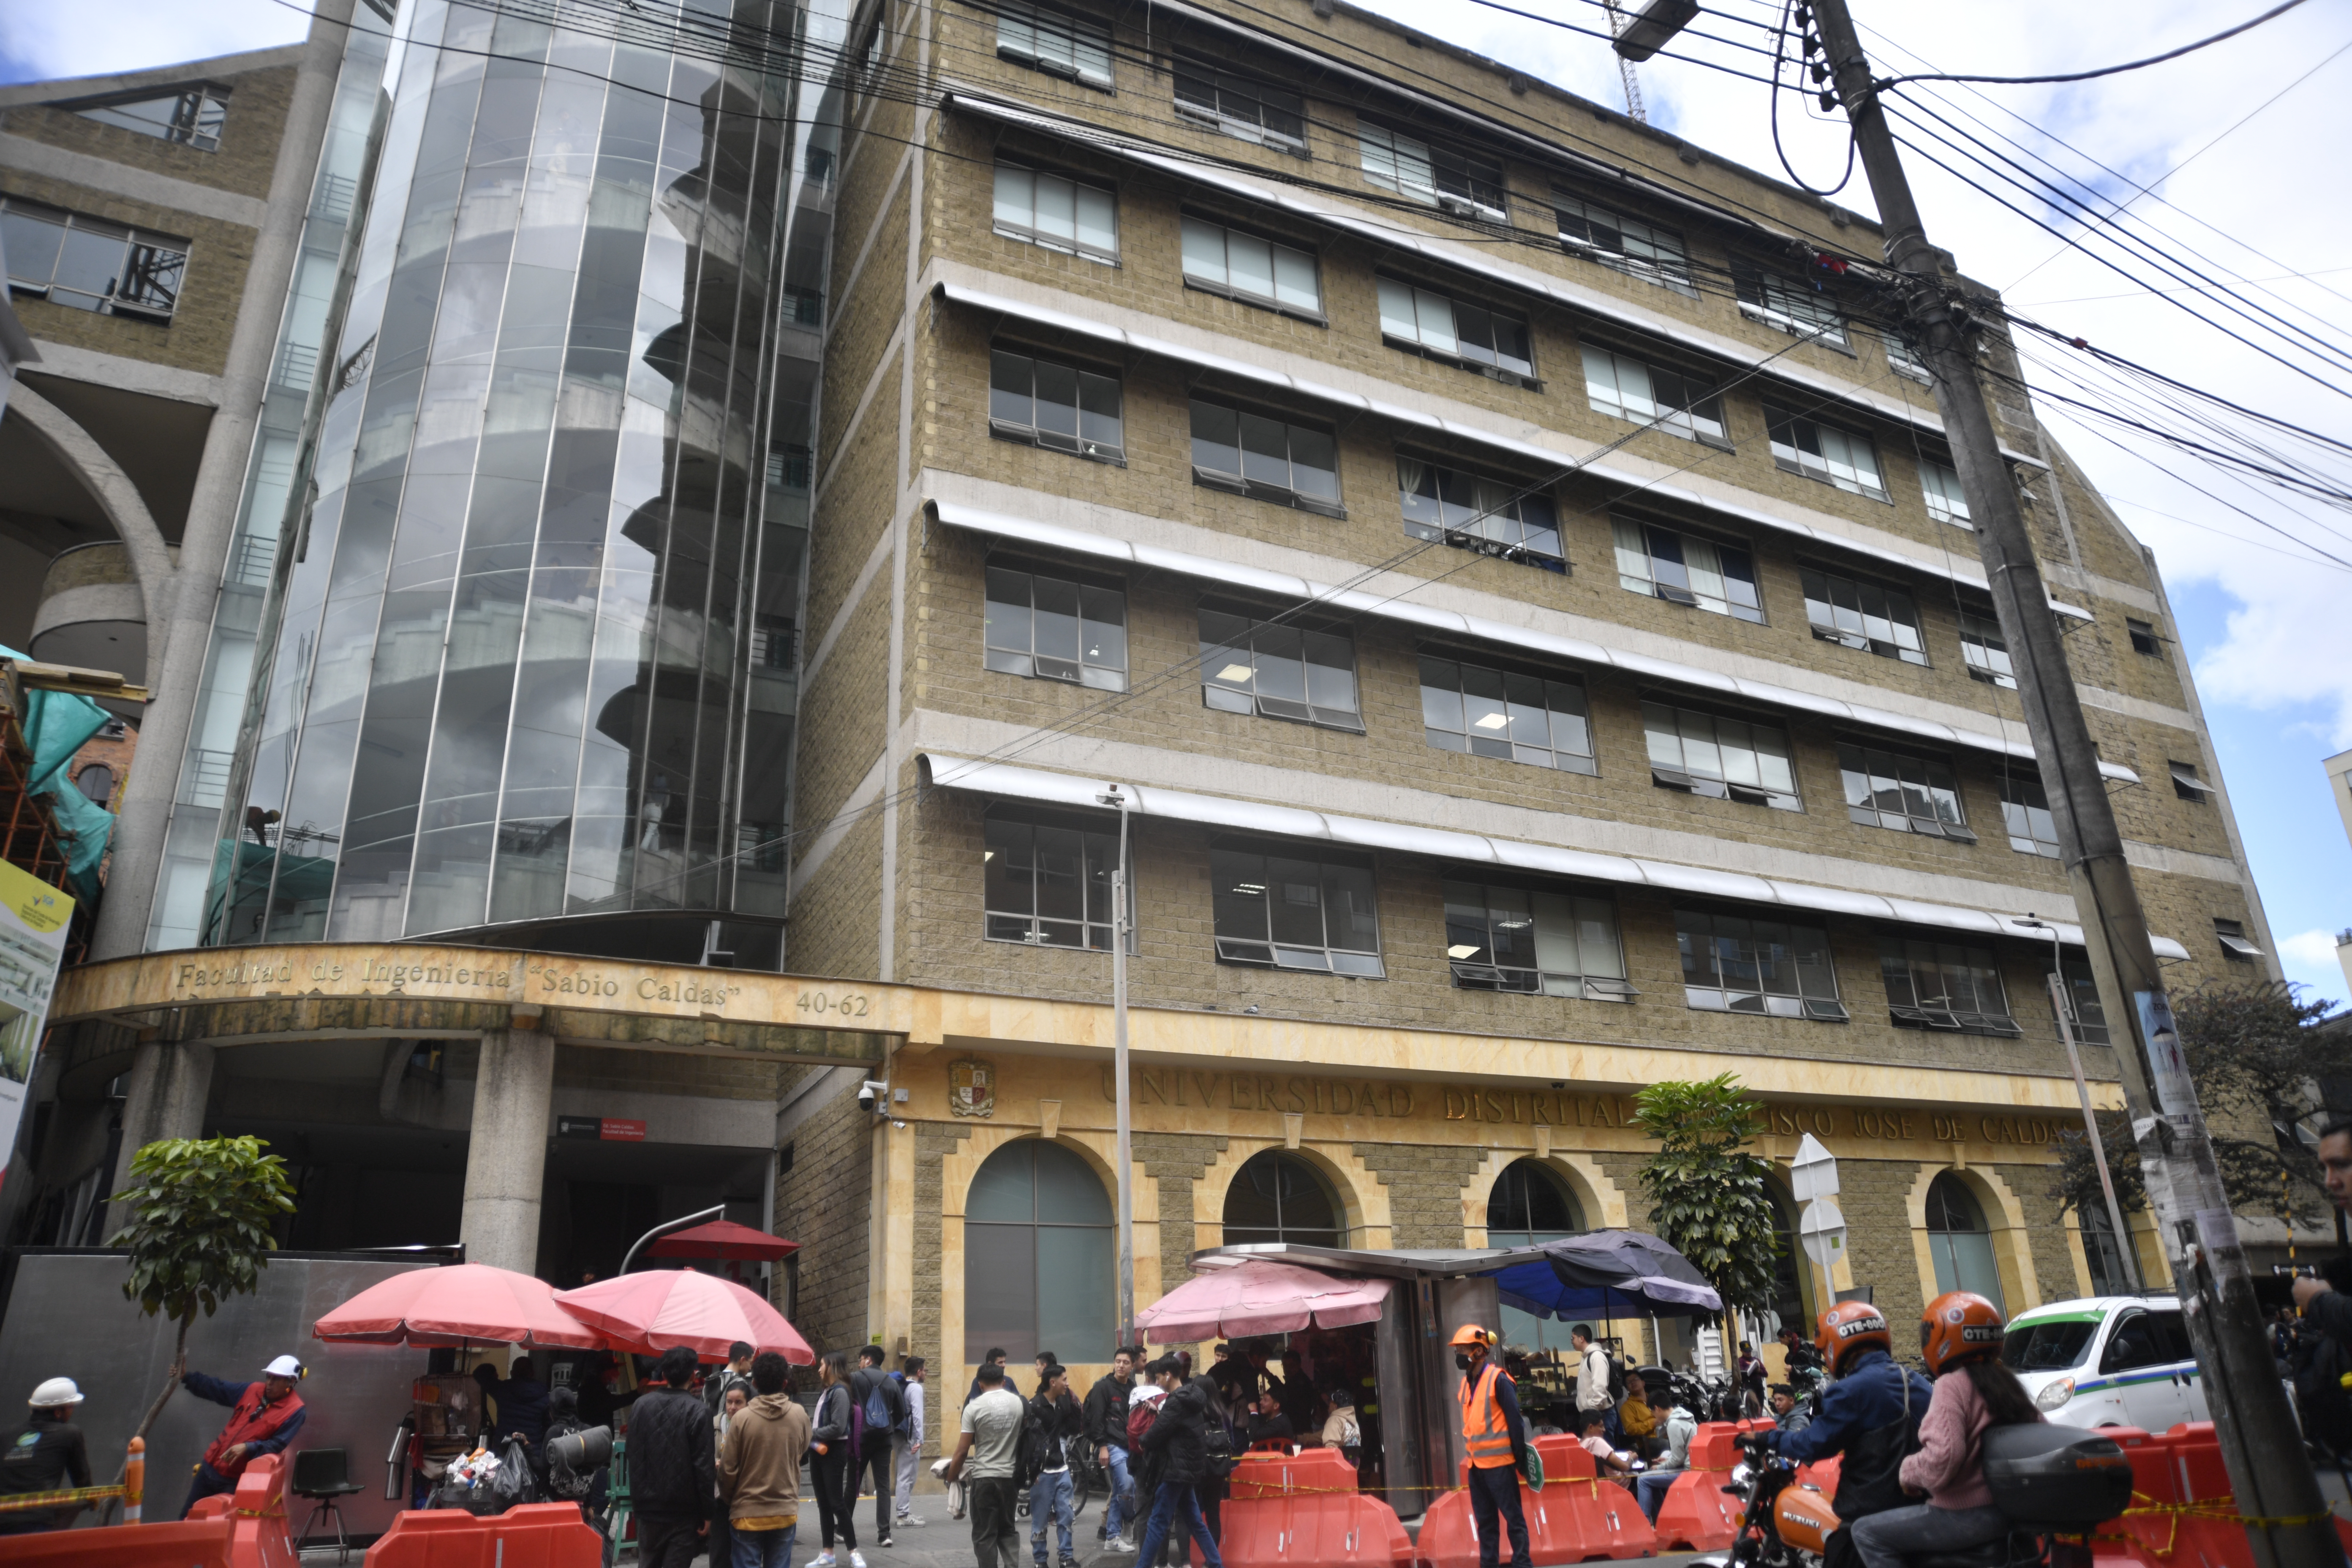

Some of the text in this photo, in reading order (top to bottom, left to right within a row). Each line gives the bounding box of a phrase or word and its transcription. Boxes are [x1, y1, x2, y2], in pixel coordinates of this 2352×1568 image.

[177, 959, 293, 987] Facultad
[311, 958, 343, 981] de
[796, 991, 868, 1016] 40-62
[1100, 1066, 1416, 1118] UNIVERSIDAD
[1443, 1089, 1636, 1128] DISTRITAL
[1853, 1110, 1916, 1140] JOSE
[1933, 1113, 1966, 1141] DE
[1526, 1452, 1537, 1481] SIGA
[1782, 1511, 1820, 1528] SUZUKI
